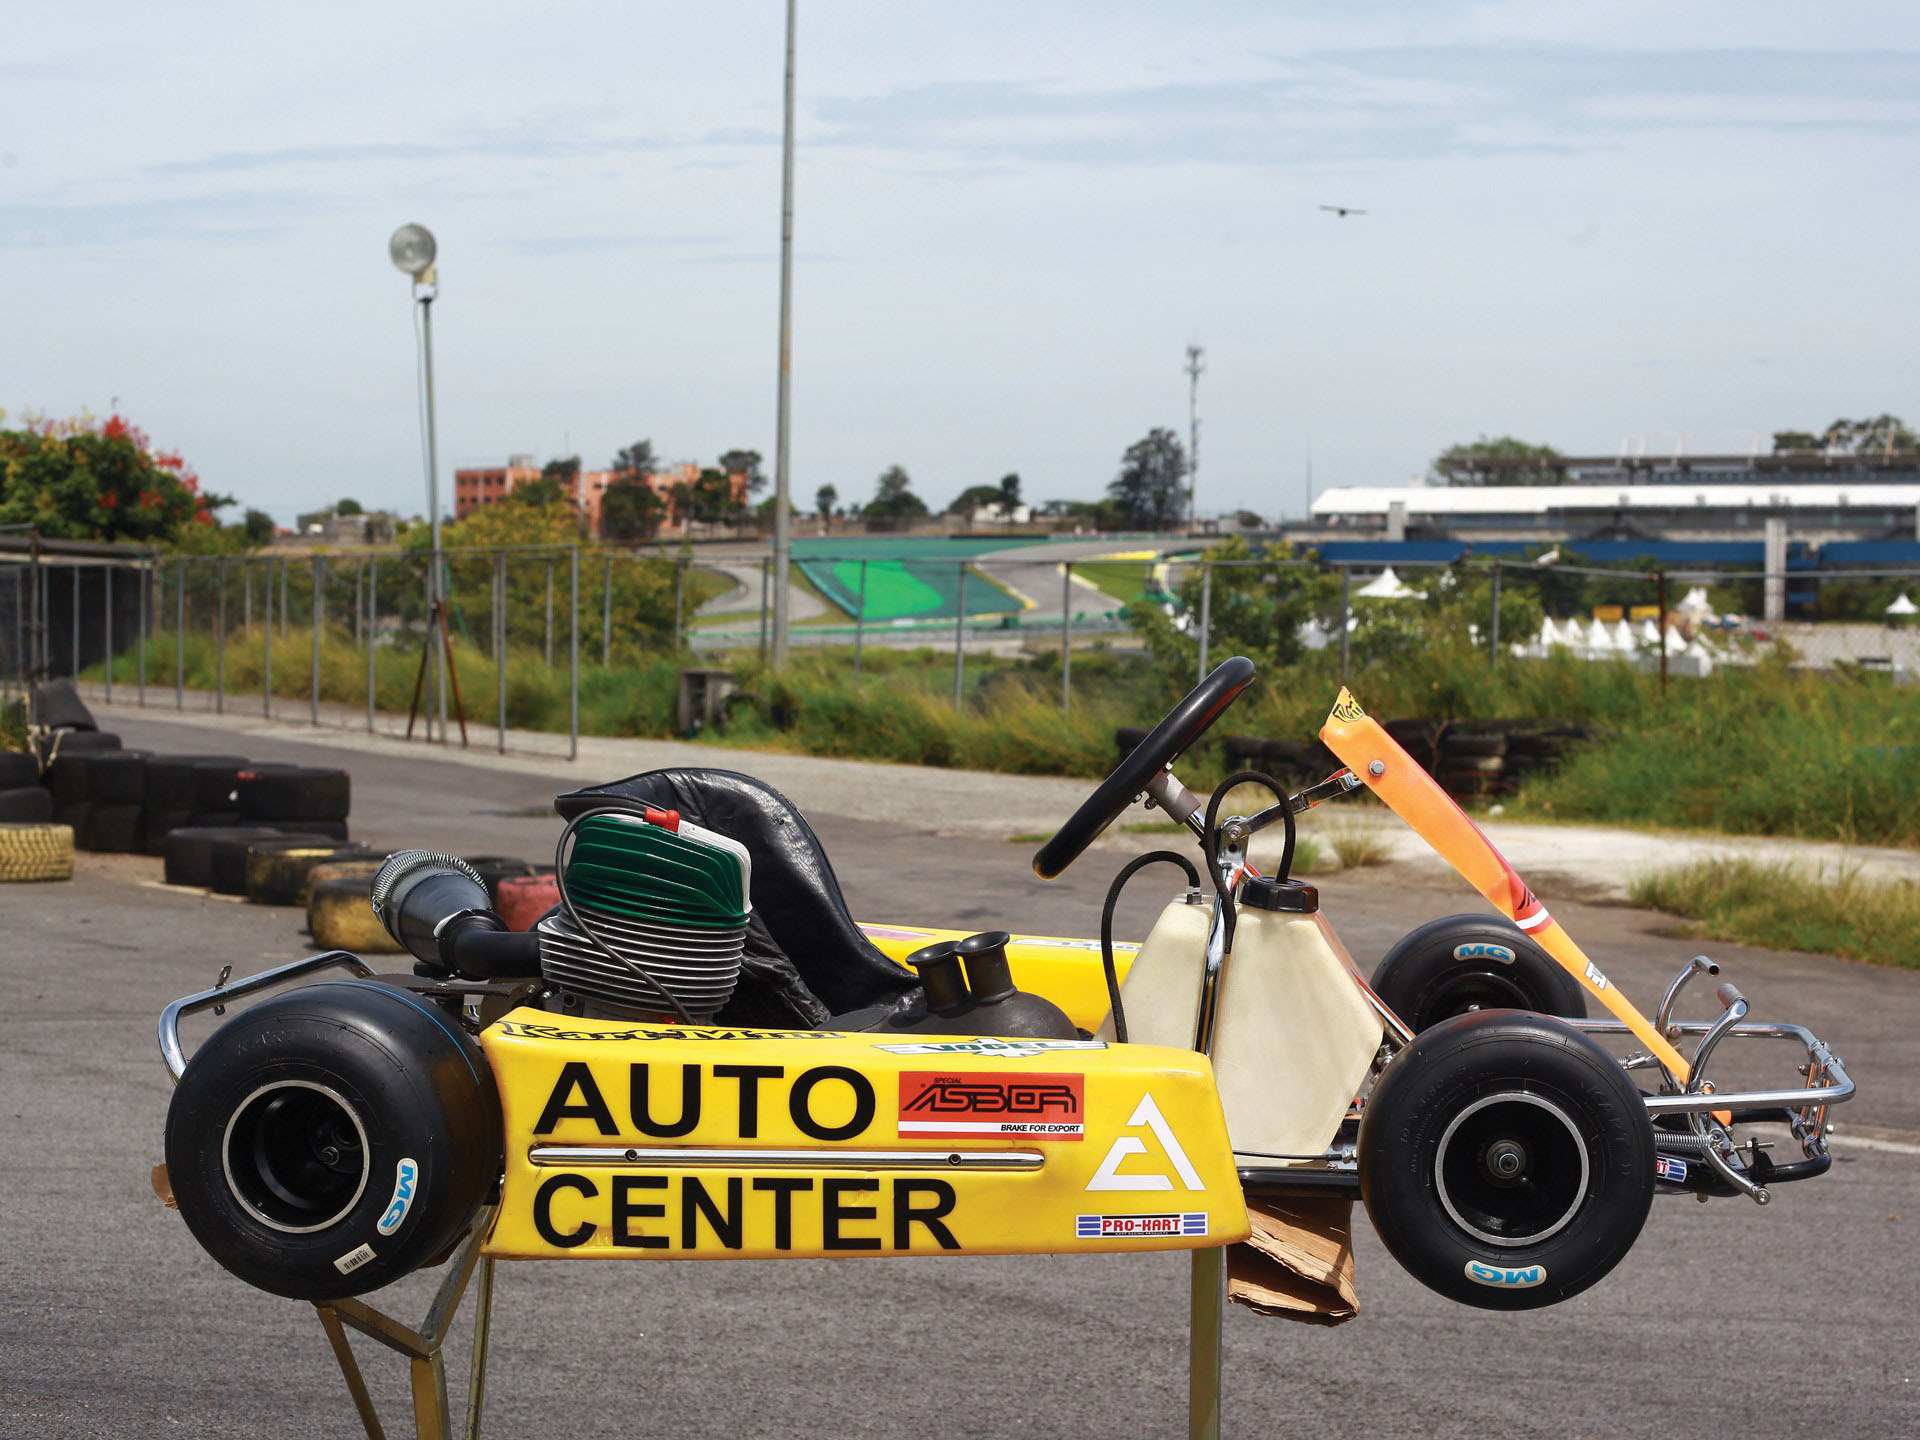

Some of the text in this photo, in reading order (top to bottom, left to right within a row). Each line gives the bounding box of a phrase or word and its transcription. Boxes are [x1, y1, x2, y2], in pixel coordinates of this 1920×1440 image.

[1459, 945, 1511, 961] MG
[921, 1042, 1074, 1052] VOGEL
[532, 1061, 876, 1141] AUTO
[1000, 1124, 1028, 1132] BRAKE
[1047, 1125, 1081, 1133] EXPORT
[380, 1164, 415, 1228] MG
[532, 1173, 963, 1250] CENTER
[1101, 1218, 1181, 1232] PRO-KART
[1472, 1263, 1538, 1284] MG
